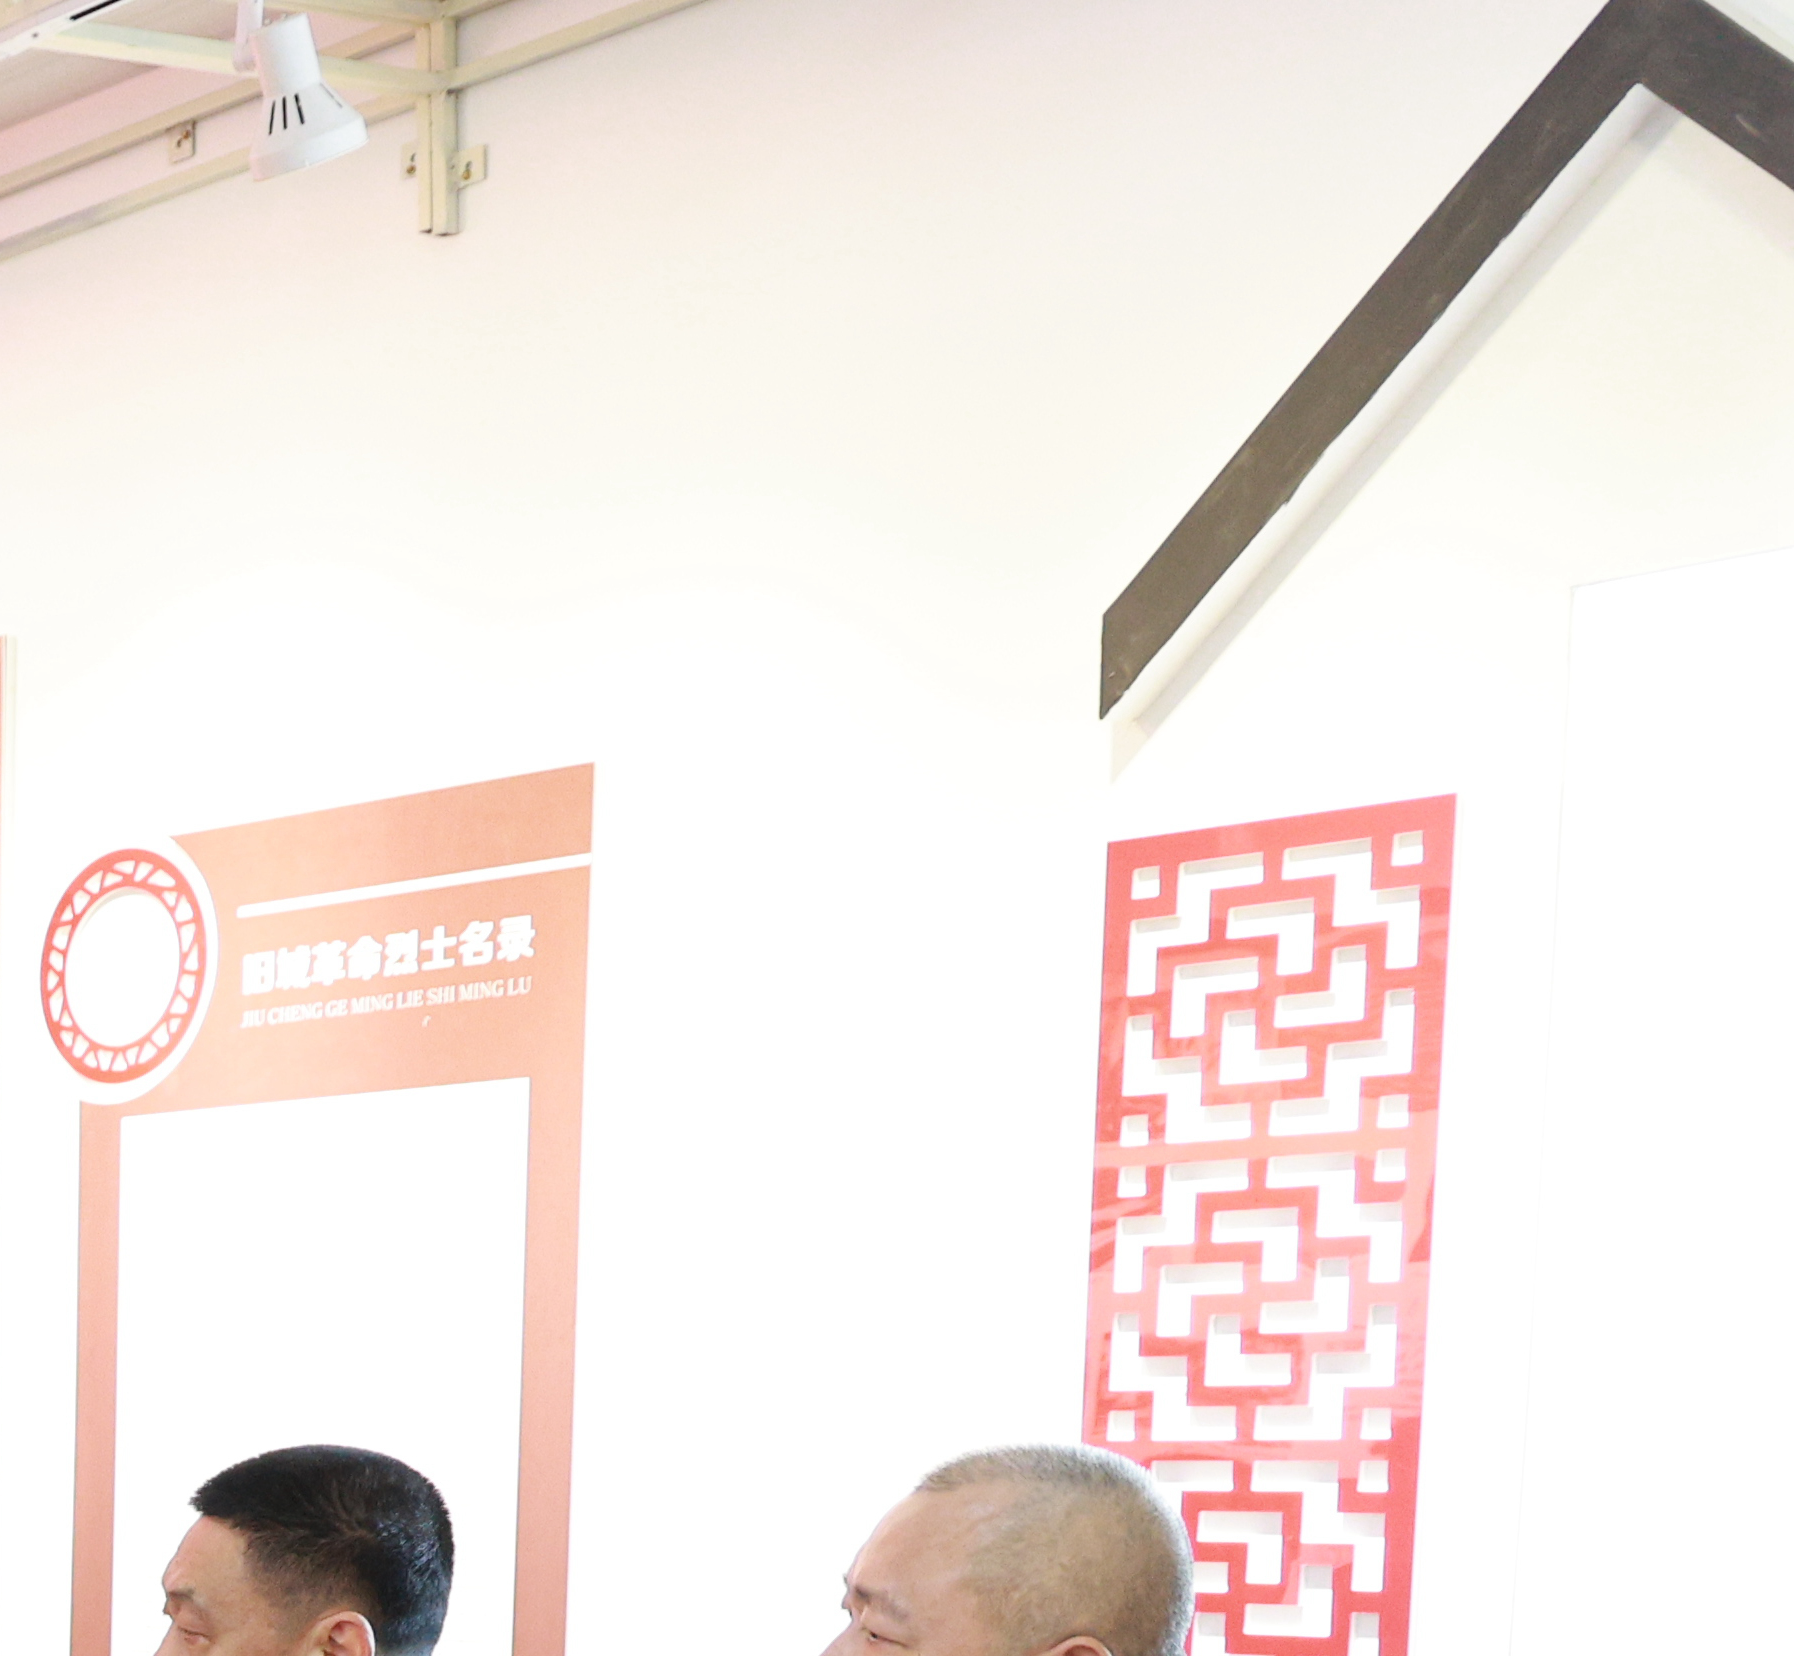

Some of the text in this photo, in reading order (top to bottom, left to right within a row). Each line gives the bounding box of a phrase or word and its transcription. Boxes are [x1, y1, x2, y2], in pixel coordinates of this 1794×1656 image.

[242, 914, 537, 995] 旧城革命烈士名录
[240, 976, 532, 1028] JIU CHENG GE MING LIE SHI MING LU
